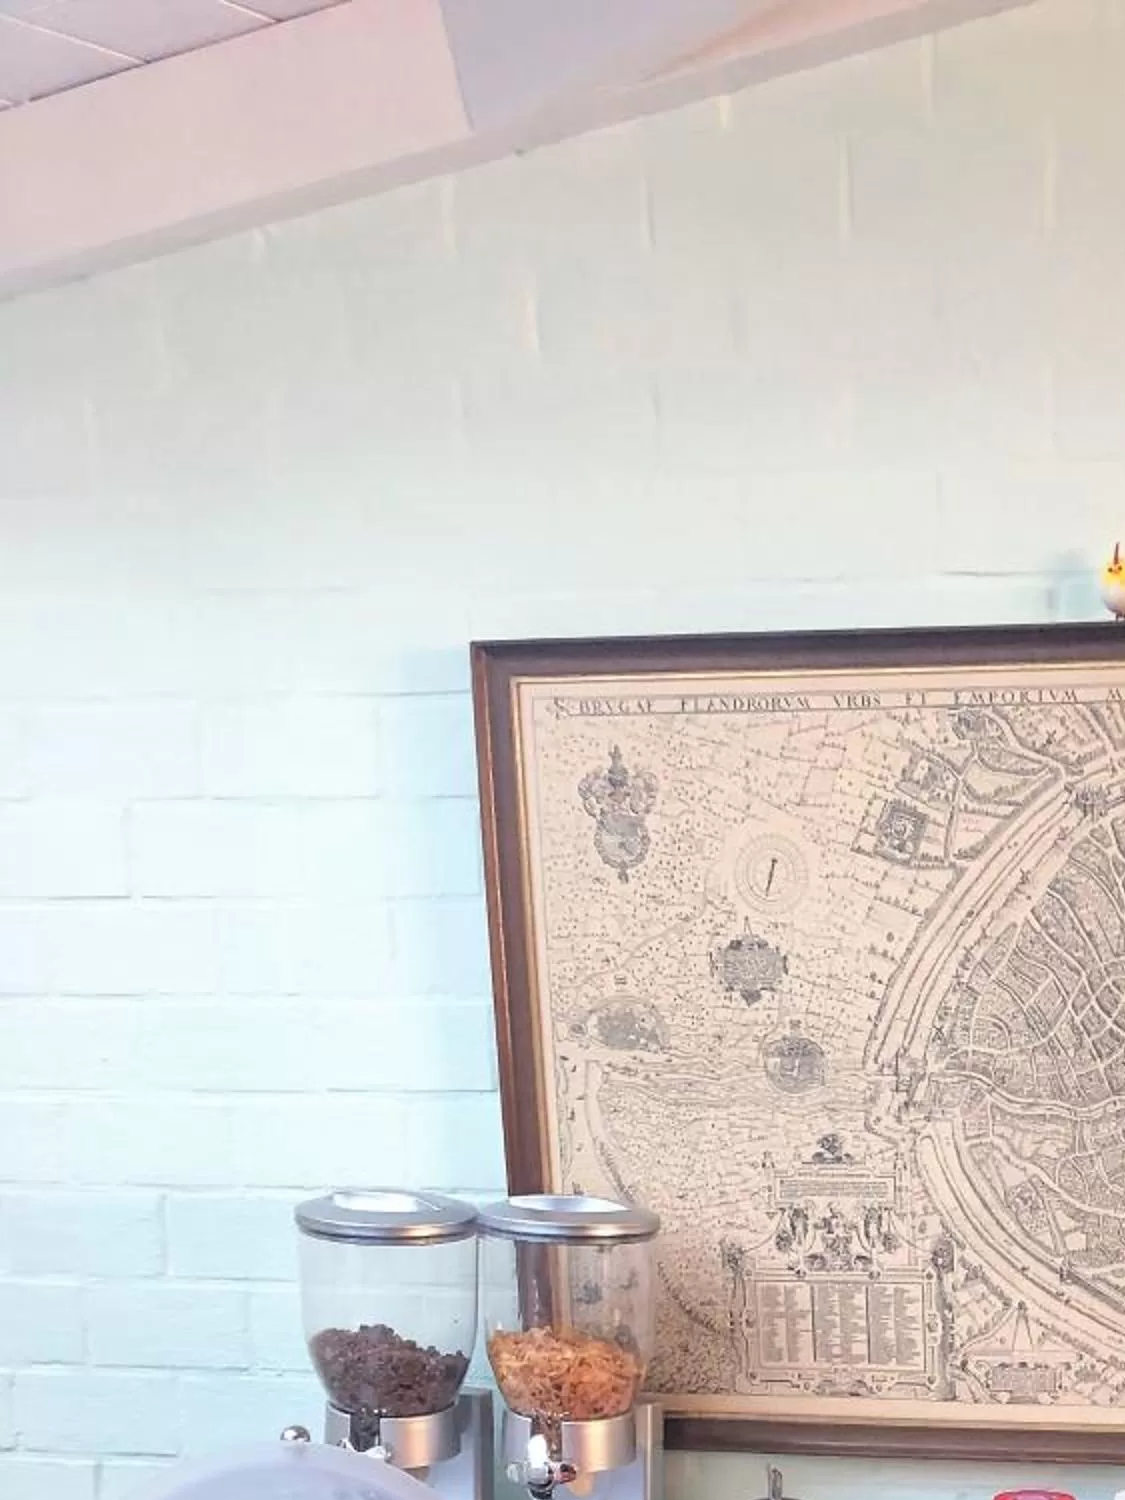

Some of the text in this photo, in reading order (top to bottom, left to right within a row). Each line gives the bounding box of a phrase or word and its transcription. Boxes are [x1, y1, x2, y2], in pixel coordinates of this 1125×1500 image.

[833, 694, 882, 709] VRBS
[905, 691, 926, 705] ET
[953, 688, 1079, 704] EMPORIVM
